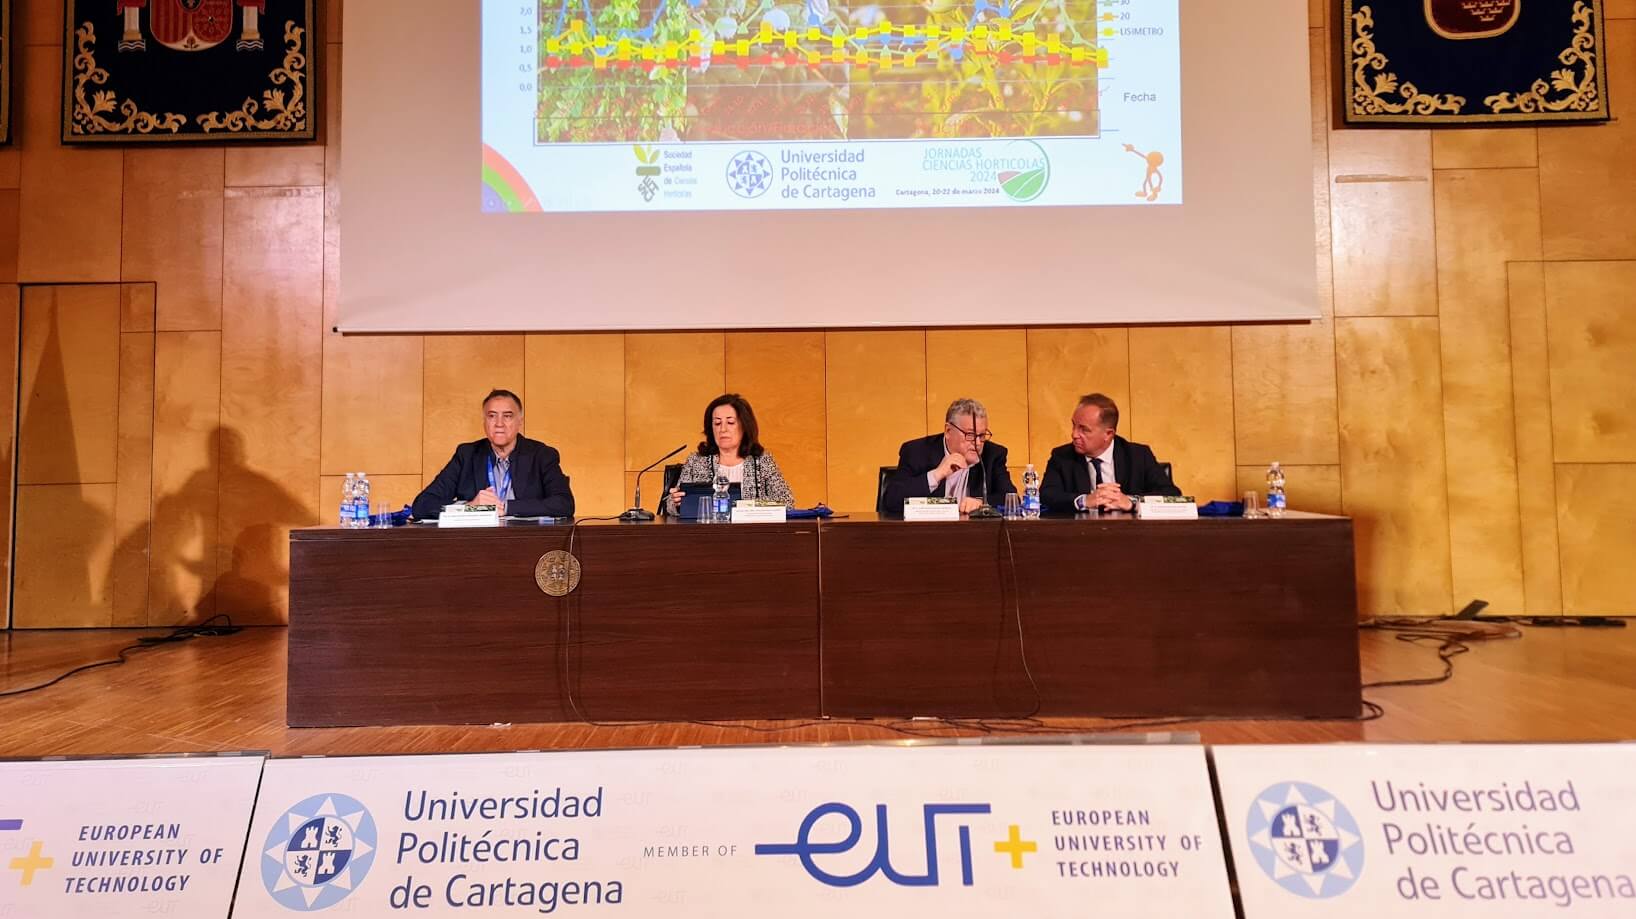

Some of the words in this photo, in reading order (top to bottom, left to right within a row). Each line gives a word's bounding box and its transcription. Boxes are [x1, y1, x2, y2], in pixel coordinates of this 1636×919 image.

[1120, 11, 1130, 20] 20
[1120, 26, 1164, 36] LISIMETRO
[1123, 91, 1157, 102] Fecha
[663, 150, 693, 159] Sociedad
[781, 148, 865, 164] Universidad
[923, 146, 983, 159] JORNADAS
[922, 159, 973, 171] CIENCIAS
[781, 166, 857, 181] Politécnica
[970, 170, 997, 182] 2024
[782, 184, 799, 199] de
[803, 182, 876, 202] Cartagena
[983, 187, 1000, 195] 2024
[404, 787, 603, 821] Universidad
[1371, 780, 1581, 812] Universidad
[1051, 810, 1150, 826] EUROPEAN
[79, 824, 181, 841] EUROPEAN
[1382, 822, 1575, 855] Politécnica
[397, 831, 579, 864] Politécnica
[1054, 835, 1166, 851] UNIVERSITY
[1180, 835, 1204, 851] OF
[72, 849, 188, 867] UNIVERSITY
[200, 848, 224, 864] OF
[643, 845, 707, 858] MEMBER
[718, 845, 737, 857] OF
[1056, 861, 1180, 877] TECHNOLOGY
[66, 875, 190, 894] TECHNOLOGY
[1396, 866, 1441, 900] de
[1451, 866, 1636, 908] Cartagena
[389, 875, 431, 909] de
[446, 874, 623, 914] Cartagena
